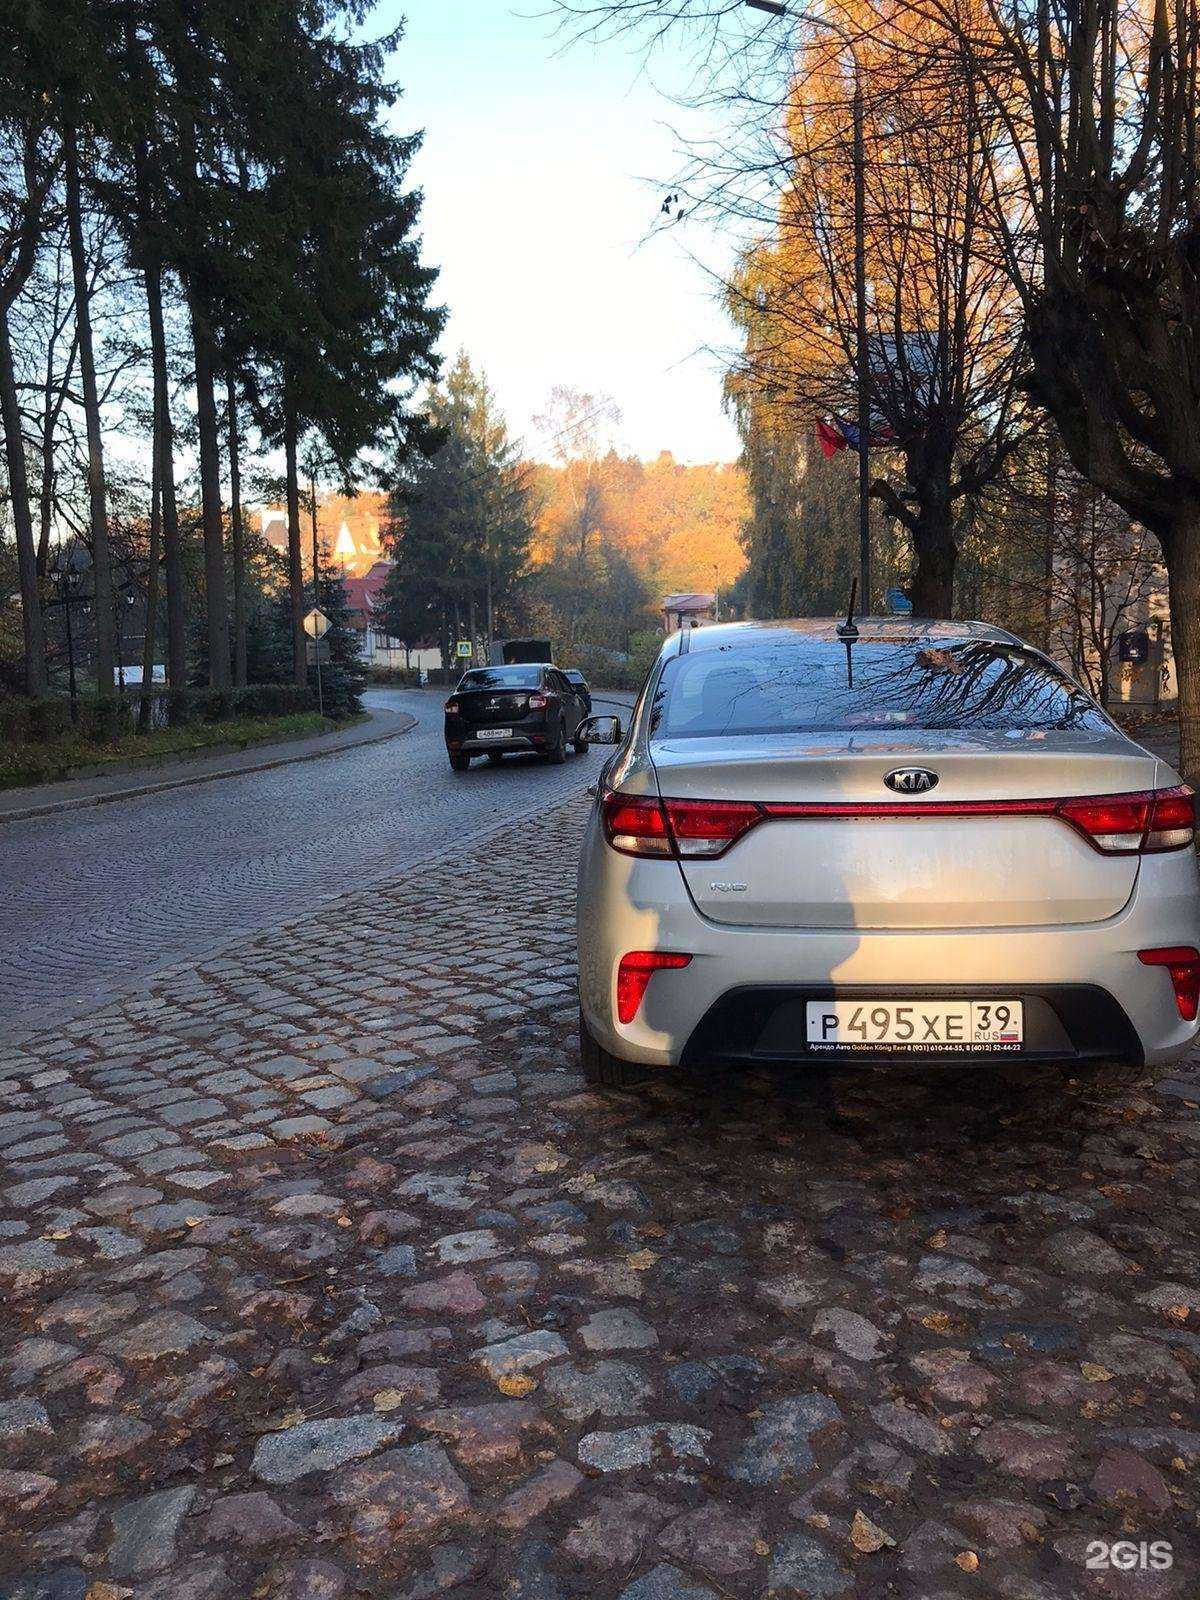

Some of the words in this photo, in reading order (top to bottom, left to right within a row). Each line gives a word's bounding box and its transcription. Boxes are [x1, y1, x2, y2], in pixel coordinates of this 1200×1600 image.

[894, 773, 931, 789] KIA
[976, 1005, 1011, 1031] 39
[974, 1031, 1000, 1041] RUS
